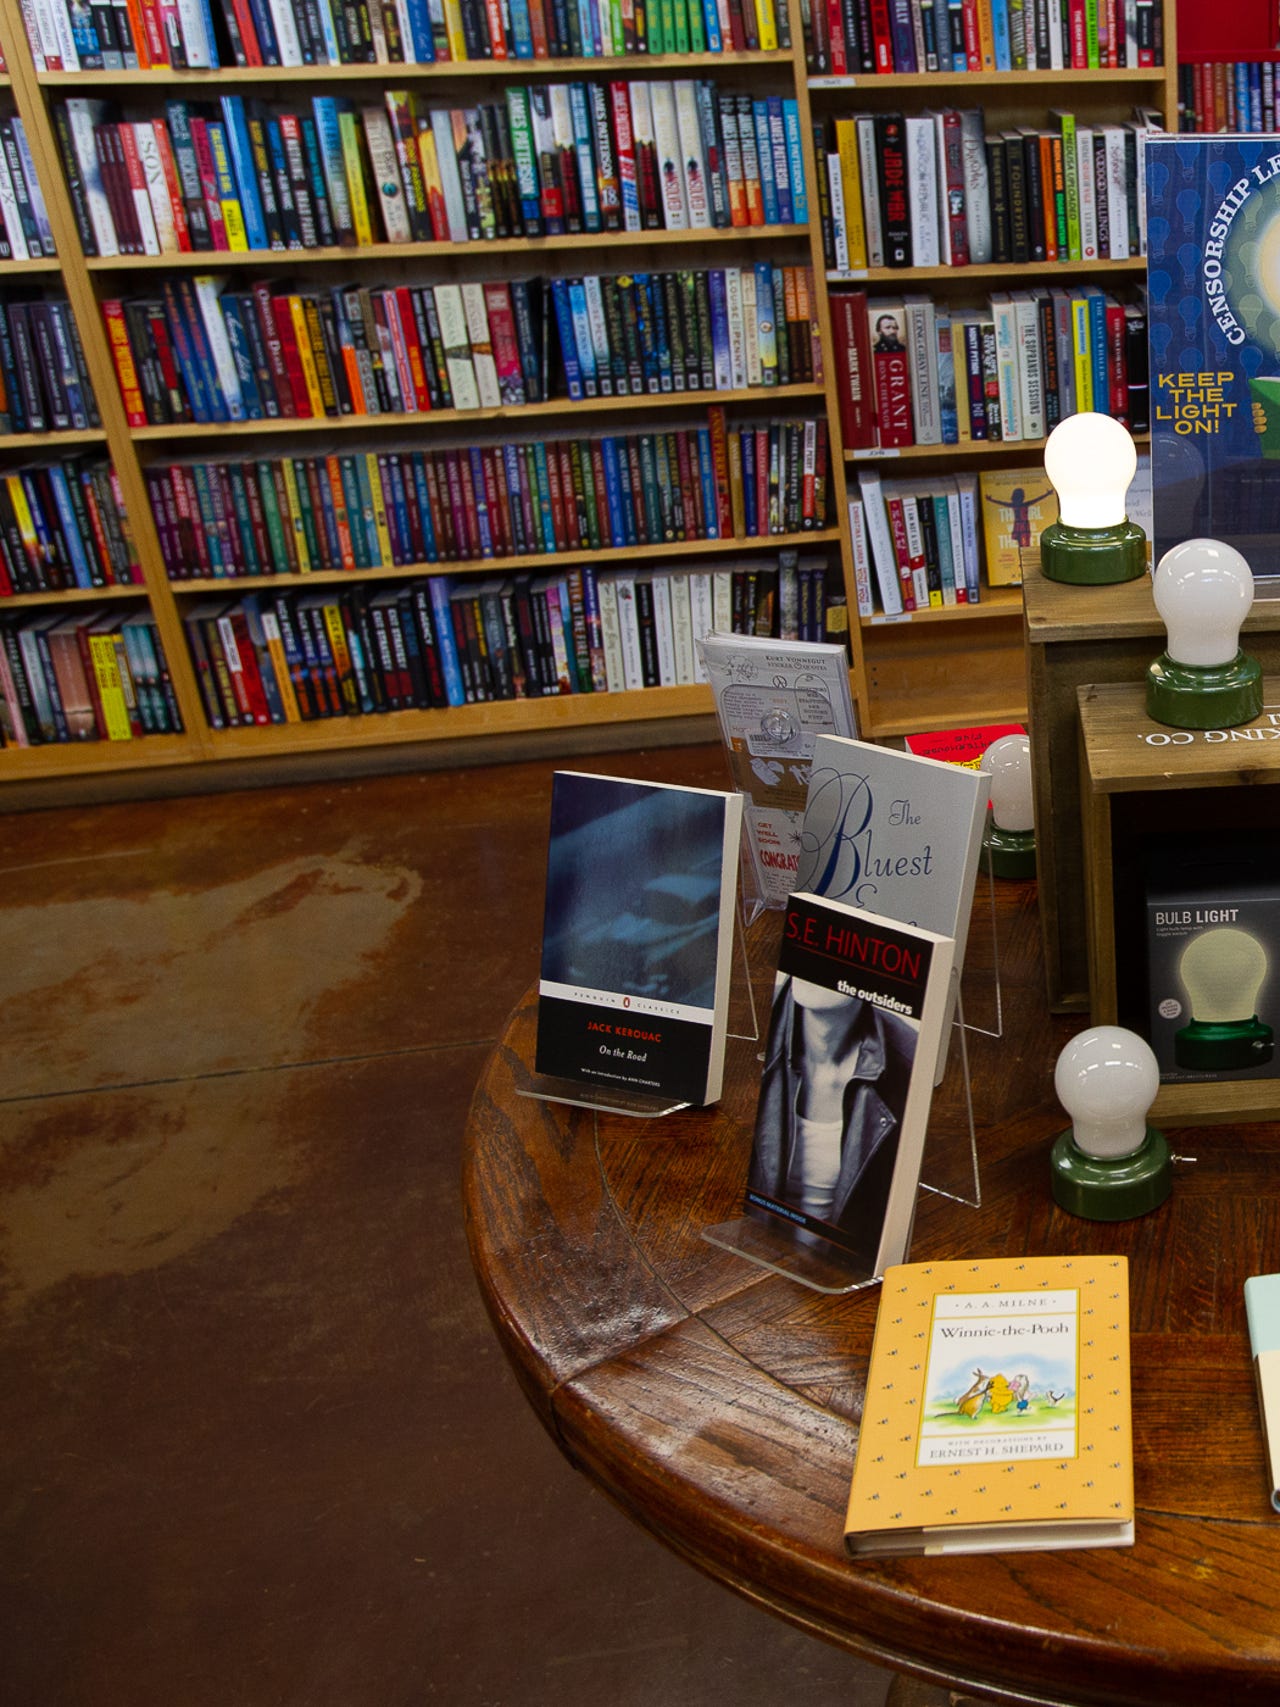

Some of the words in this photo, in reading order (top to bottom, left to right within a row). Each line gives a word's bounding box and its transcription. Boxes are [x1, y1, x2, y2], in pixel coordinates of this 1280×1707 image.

[512, 92, 528, 132] JAMES
[281, 119, 295, 139] SAY
[769, 115, 785, 144] JAMES
[285, 138, 304, 181] NOTHING
[1064, 131, 1075, 166] MEDUSA
[516, 133, 536, 194] PATTERSON
[773, 144, 789, 190] PATTERSON
[883, 147, 898, 186] JADE
[294, 190, 309, 217] BRAD
[886, 188, 906, 223] WAR
[1013, 165, 1025, 247] FOUNDRYSIDE
[1067, 167, 1078, 221] UPLOADED
[301, 218, 316, 247] PARKS
[1204, 177, 1252, 346] CENSORSHIP
[729, 279, 740, 319] LOUISE
[734, 330, 744, 369] PENNY
[968, 326, 977, 350] MONTY
[848, 348, 858, 372] MARK
[970, 351, 979, 375] PYTHON
[1028, 339, 1038, 379] SOPRANOS
[850, 374, 861, 401] TWAIN
[1158, 372, 1234, 388] KEEP
[880, 375, 890, 430] CHERNOW
[890, 359, 908, 430] GRANT
[1031, 380, 1040, 415] SESSIONS
[1169, 388, 1224, 403] THE
[1156, 403, 1237, 420] LIGHT
[1174, 420, 1220, 435] ON!
[852, 506, 862, 539] CHRISTINA
[855, 540, 864, 565] LAUREN
[416, 592, 426, 609] THE
[373, 610, 383, 628] EXIT
[420, 610, 433, 645] AGENCY
[377, 630, 393, 671] STRATEGY
[765, 654, 784, 662] KURT
[786, 656, 826, 665] VONNEGUT
[1137, 731, 1194, 747] CO.
[888, 800, 922, 826] The
[757, 829, 779, 838] WELL
[758, 837, 781, 846] SOON
[800, 767, 933, 897] Bluest
[1156, 911, 1192, 925] BULB
[1196, 909, 1239, 923] LIGHT
[785, 912, 820, 946] S.E.
[825, 927, 921, 980] HINTON
[574, 992, 615, 1003] PENGUIN
[637, 1003, 680, 1015] CLASSICS
[837, 979, 855, 997] the
[857, 986, 913, 1016] outsiders
[587, 1021, 612, 1033] JACK
[615, 1026, 662, 1043] KEROUAC
[599, 1044, 611, 1056] On
[613, 1048, 625, 1058] the
[626, 1050, 647, 1062] Road
[981, 1301, 993, 1309] A.
[999, 1299, 1048, 1308] MILNE
[940, 1323, 1070, 1339] Winnie-the-Pooh
[930, 1447, 981, 1459] ERNEST
[985, 1446, 999, 1457] H.
[1002, 1443, 1064, 1455] SHEPARD
